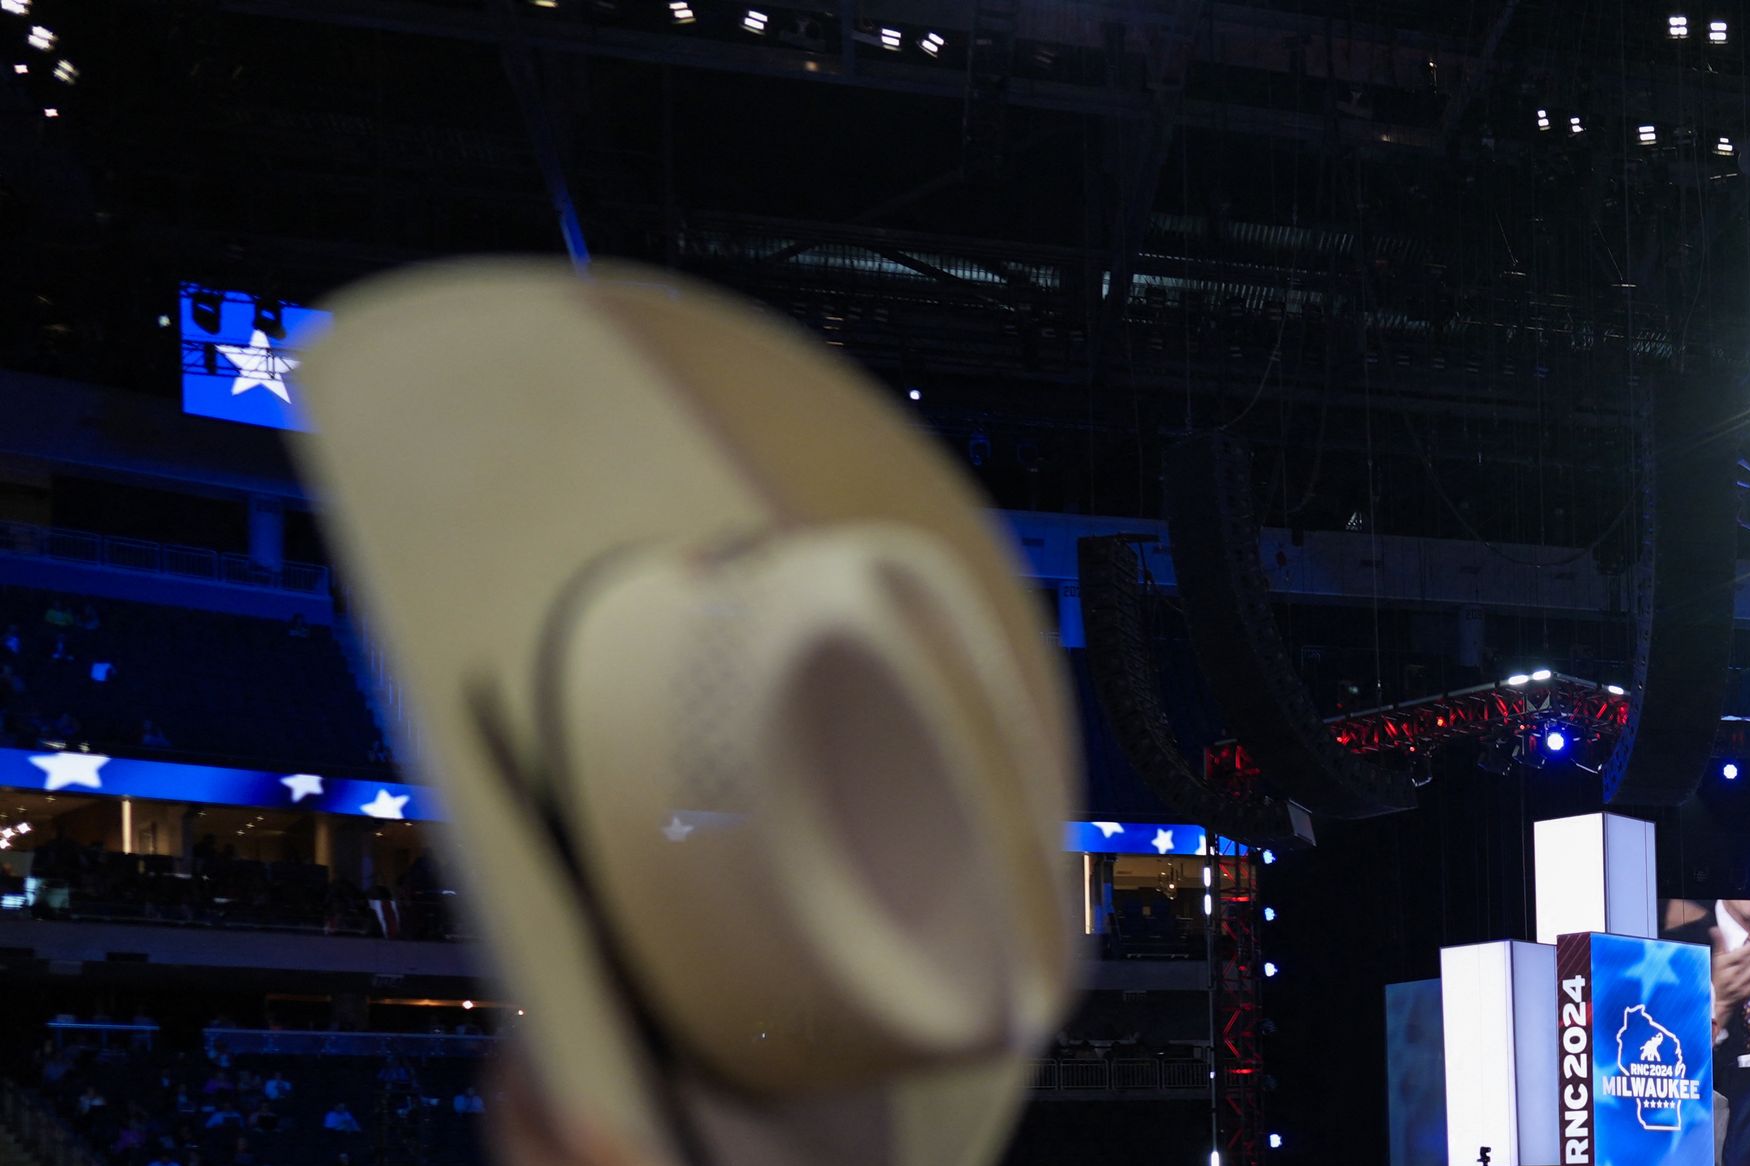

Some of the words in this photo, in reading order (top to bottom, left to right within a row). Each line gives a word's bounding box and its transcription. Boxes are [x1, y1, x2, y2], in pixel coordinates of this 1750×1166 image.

[1562, 974, 1588, 1079] 2024
[1602, 1075, 1700, 1100] MILWAUKEE
[1630, 1063, 1650, 1076] RNC
[1650, 1064, 1673, 1077] 2024
[1564, 1083, 1589, 1164] RNC
